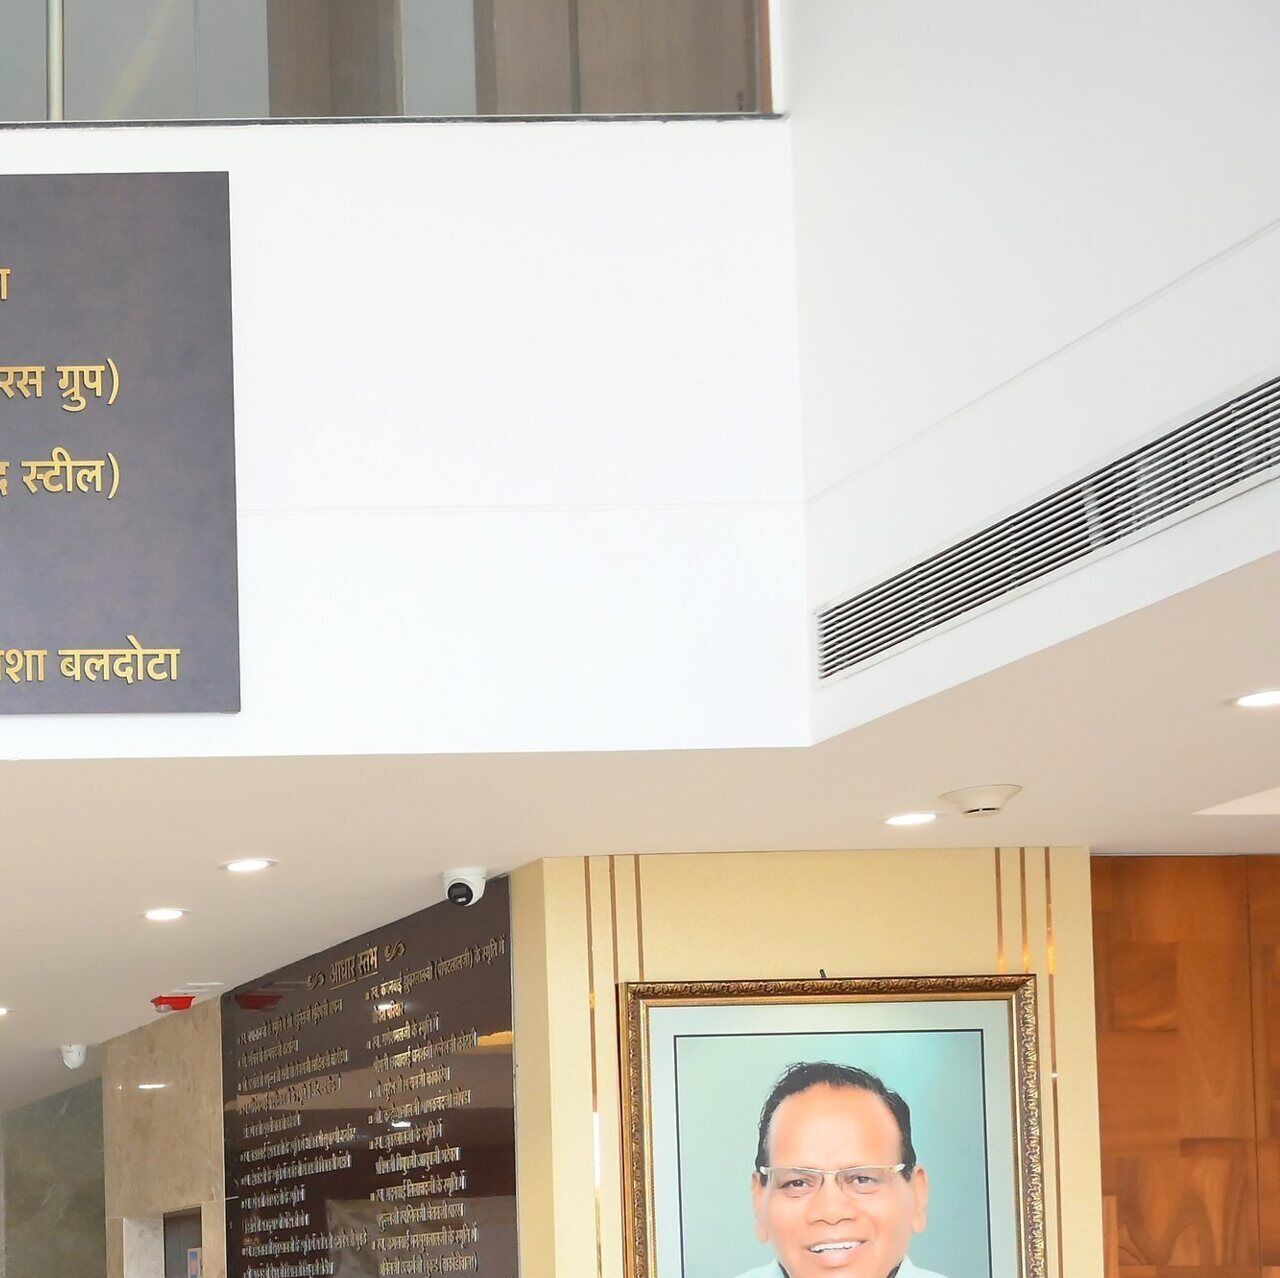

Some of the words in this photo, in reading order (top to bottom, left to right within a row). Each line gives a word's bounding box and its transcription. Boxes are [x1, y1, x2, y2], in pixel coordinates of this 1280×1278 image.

[56, 358, 120, 412] ग्रुप)
[21, 446, 120, 499] स्टील)
[58, 635, 181, 684] बलदोटा
[329, 958, 355, 982] आधार
[357, 942, 378, 973] स्तंभ
